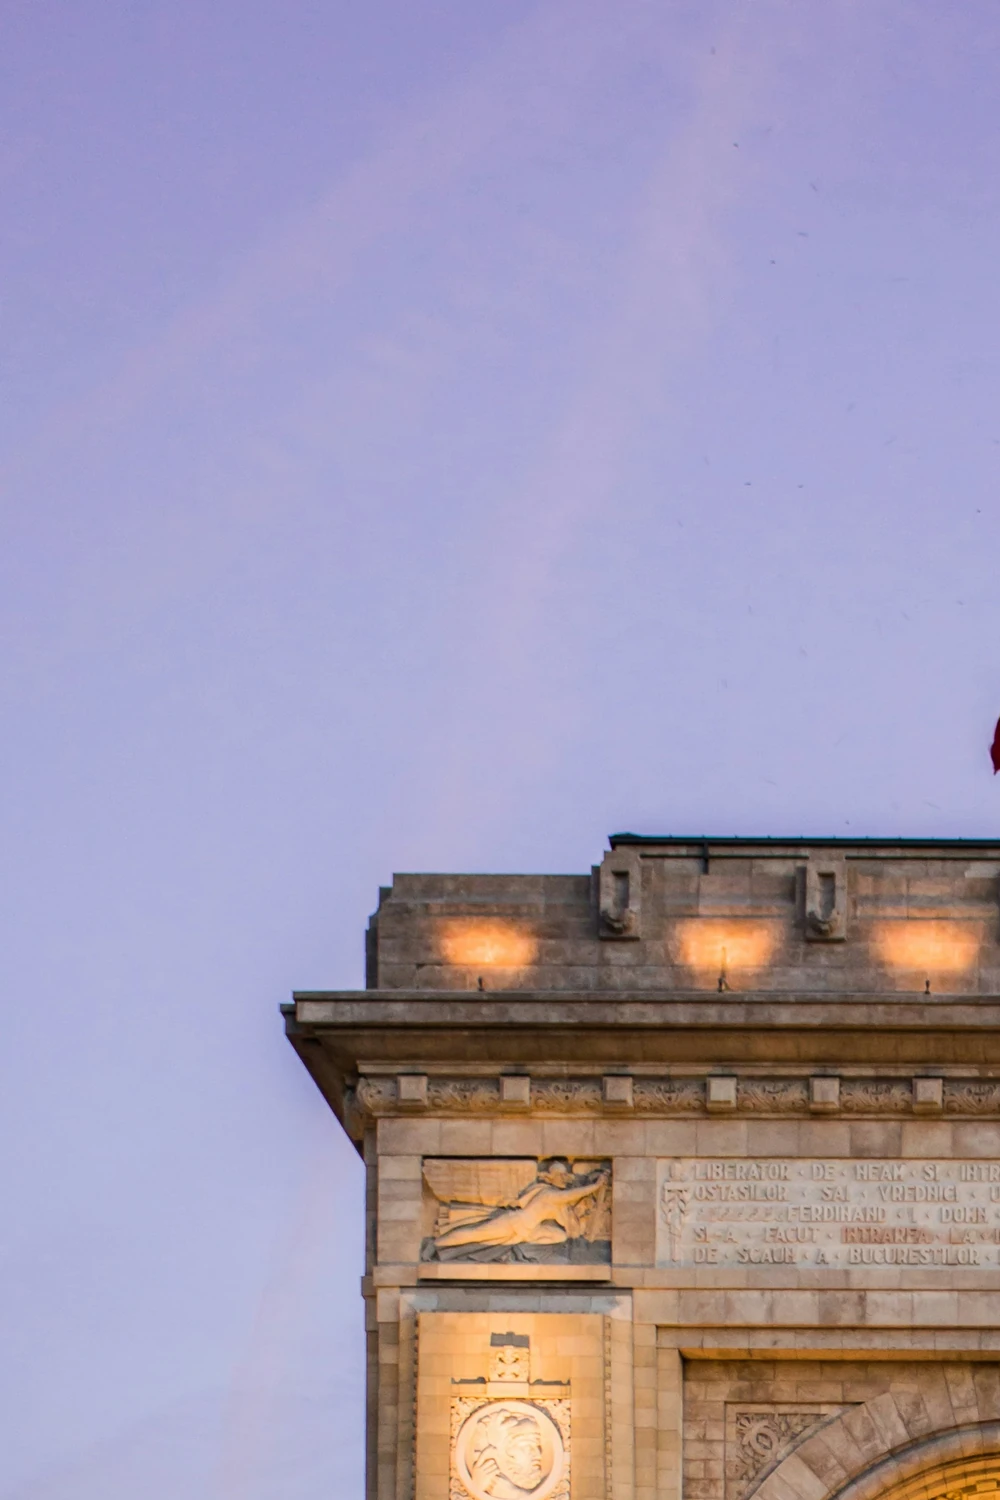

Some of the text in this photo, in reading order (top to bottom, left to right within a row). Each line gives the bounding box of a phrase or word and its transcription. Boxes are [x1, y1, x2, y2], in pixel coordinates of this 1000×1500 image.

[694, 1163, 790, 1181] LIBERATOR
[812, 1164, 835, 1181] DE
[854, 1164, 906, 1182] NEAM
[694, 1185, 790, 1202] OSTASILOR
[878, 1185, 959, 1203] VREDNICI
[787, 1206, 886, 1223] FERDINAND
[940, 1207, 988, 1224] DOMN
[841, 1227, 933, 1244] INTRAREA
[949, 1228, 975, 1244] LA
[694, 1247, 718, 1265] DE
[737, 1247, 797, 1265] SCAUN
[815, 1248, 830, 1265] A
[848, 1248, 980, 1266] BUCURESTILOR
